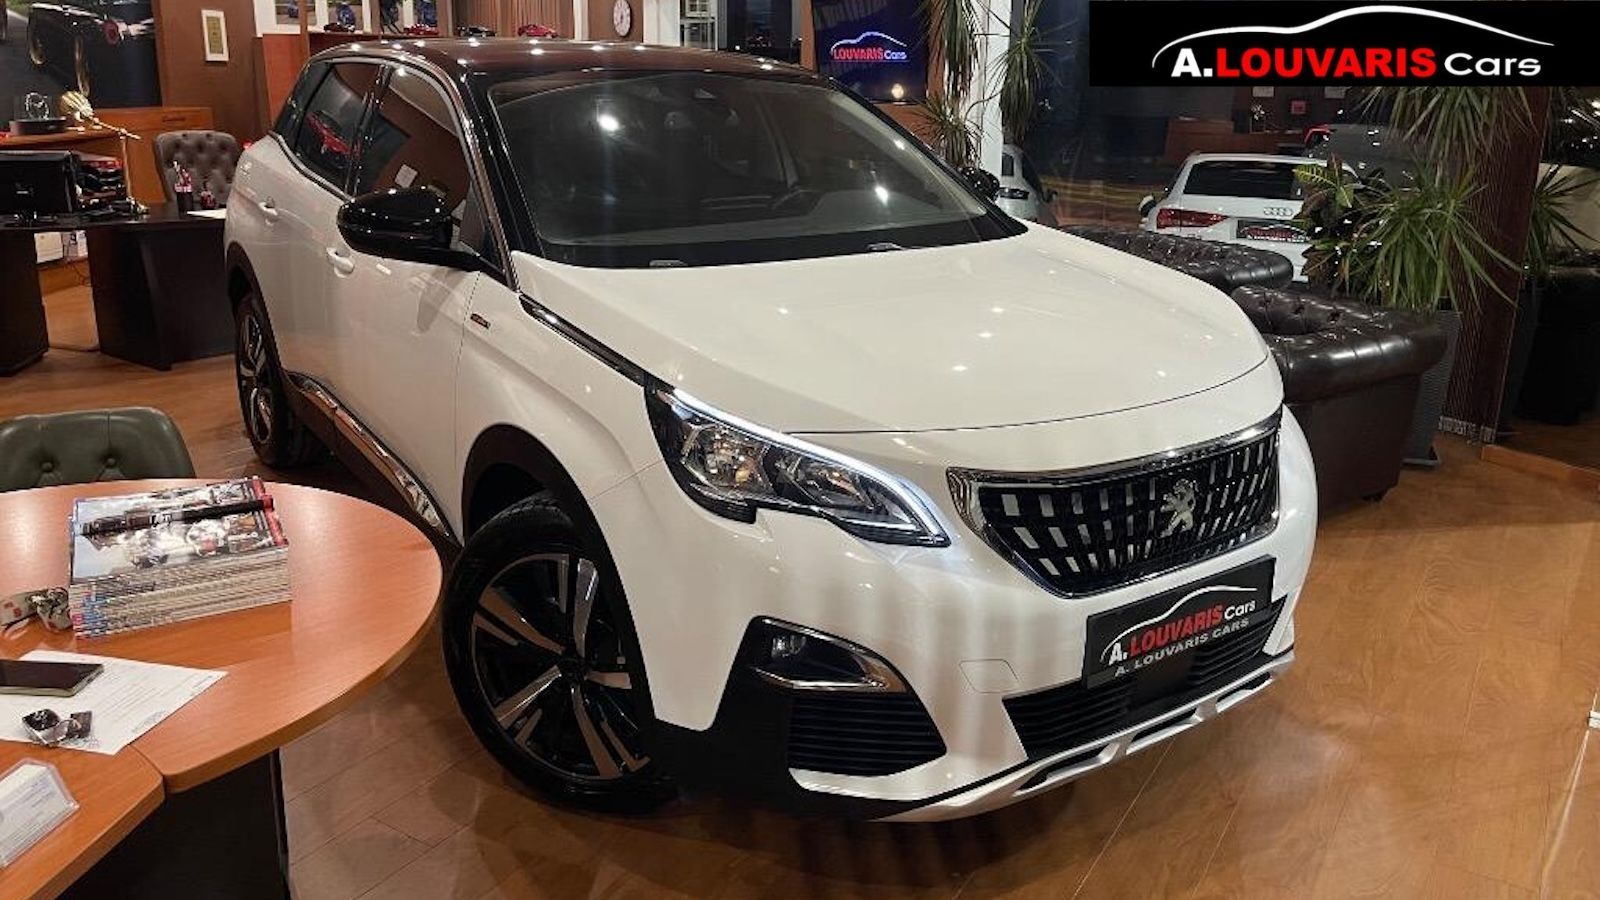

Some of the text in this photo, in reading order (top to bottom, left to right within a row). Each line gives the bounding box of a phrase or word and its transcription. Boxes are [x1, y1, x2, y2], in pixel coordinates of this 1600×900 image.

[1224, 600, 1256, 620] Cars
[1134, 633, 1208, 669] LOUVARIS
[1212, 617, 1249, 638] CARS
